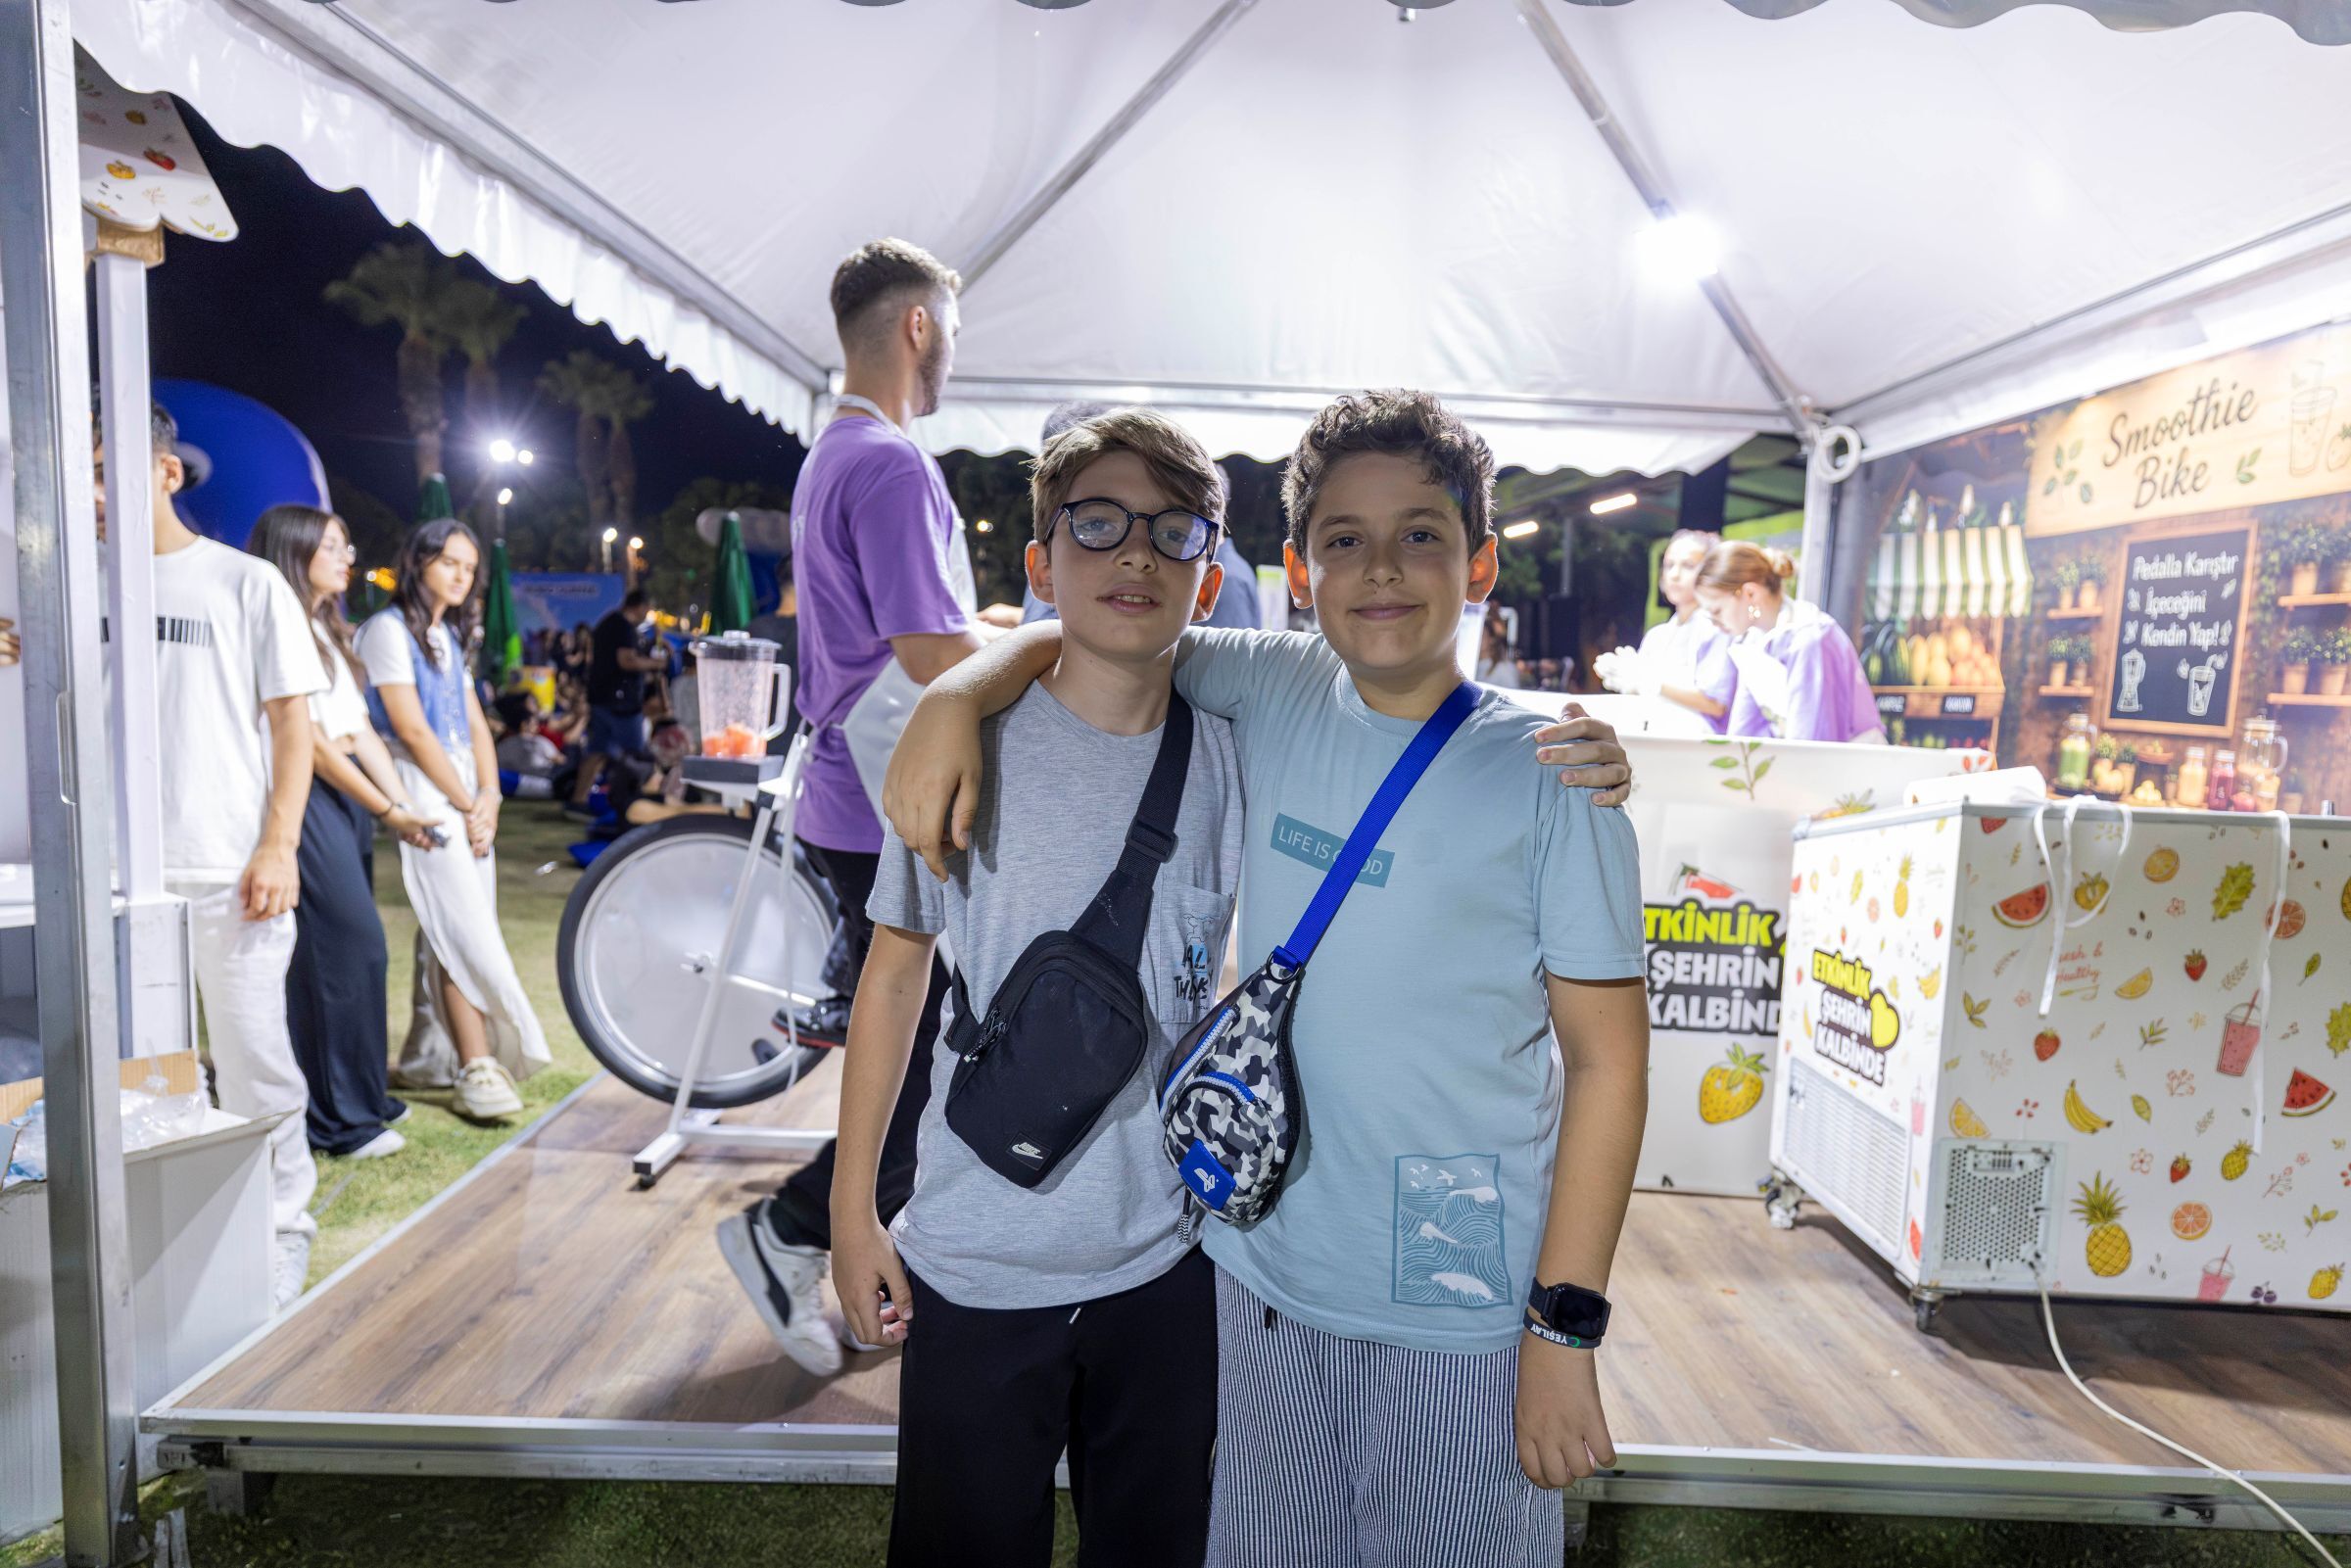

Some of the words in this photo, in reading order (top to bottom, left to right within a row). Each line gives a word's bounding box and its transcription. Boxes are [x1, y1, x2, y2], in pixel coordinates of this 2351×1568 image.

[2103, 378, 2258, 467] Smoothie
[2135, 447, 2210, 508] Bike
[2140, 622, 2186, 646] Kendin
[2188, 621, 2219, 652] Yap!
[1278, 826, 1313, 853] LIFE
[1314, 841, 1331, 860] IS
[1644, 902, 1774, 946] TKİNLİK
[1651, 946, 1780, 989] ŞEHRİN
[1812, 950, 1871, 1000] ETKİNLİK
[1648, 989, 1781, 1031] KALBİND
[1822, 996, 1872, 1038] ŞEHRİN
[1816, 1031, 1884, 1084] KALBİNDE
